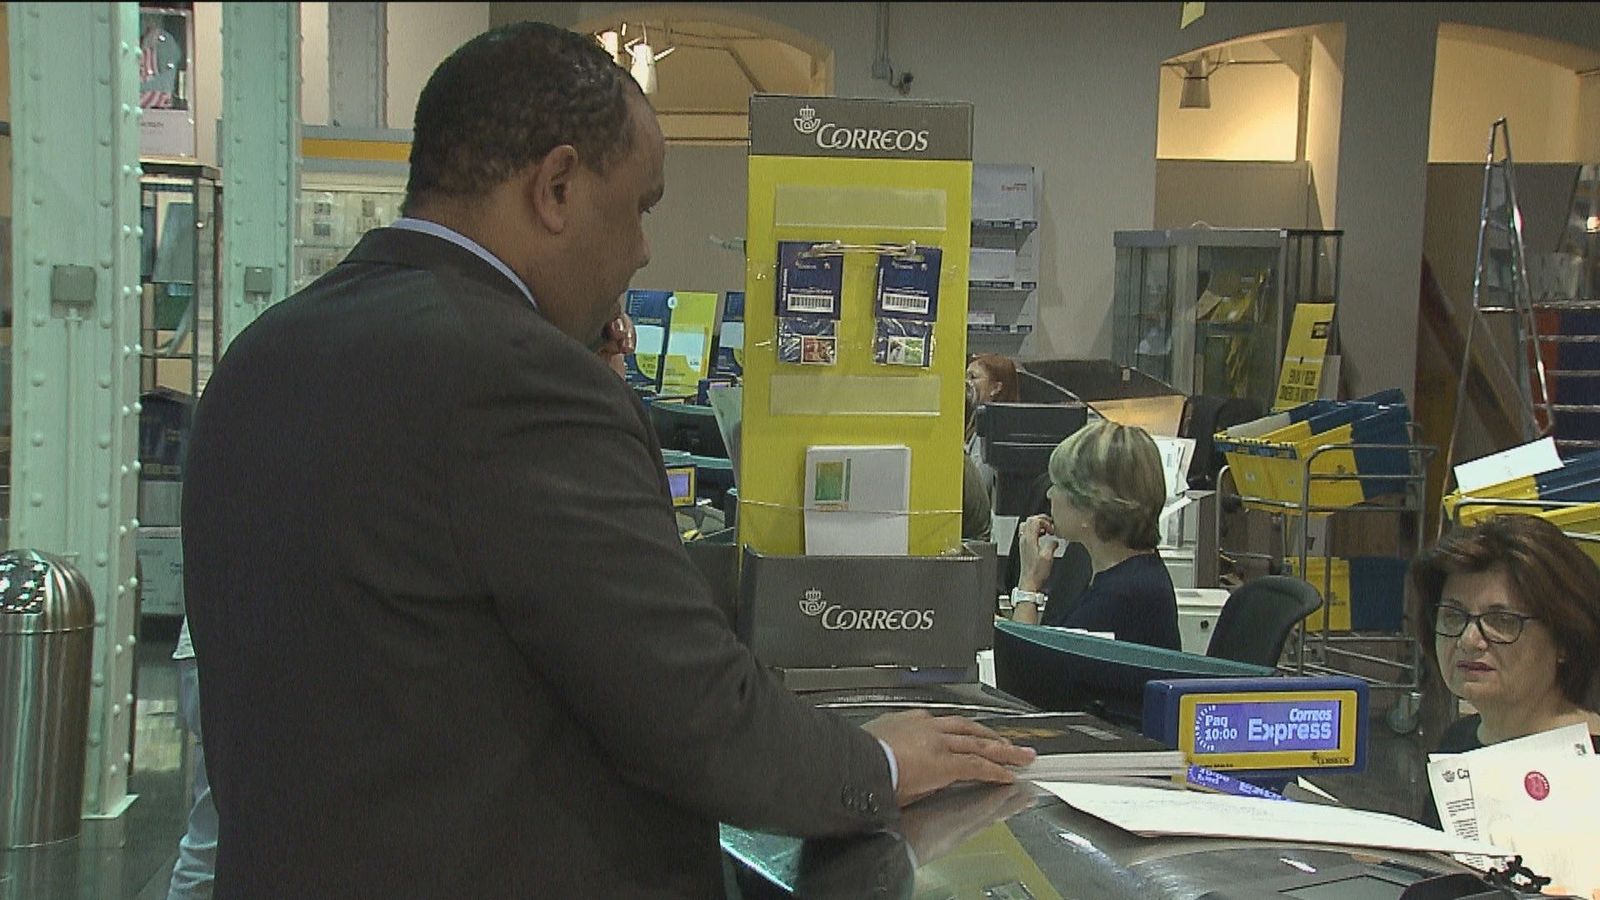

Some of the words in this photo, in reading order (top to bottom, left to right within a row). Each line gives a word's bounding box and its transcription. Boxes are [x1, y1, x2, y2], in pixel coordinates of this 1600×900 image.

[816, 123, 929, 151] CORREOS
[821, 604, 935, 630] CORREOS
[1204, 728, 1238, 741] 10:00
[1205, 715, 1229, 729] Paq
[1248, 718, 1332, 746] Express
